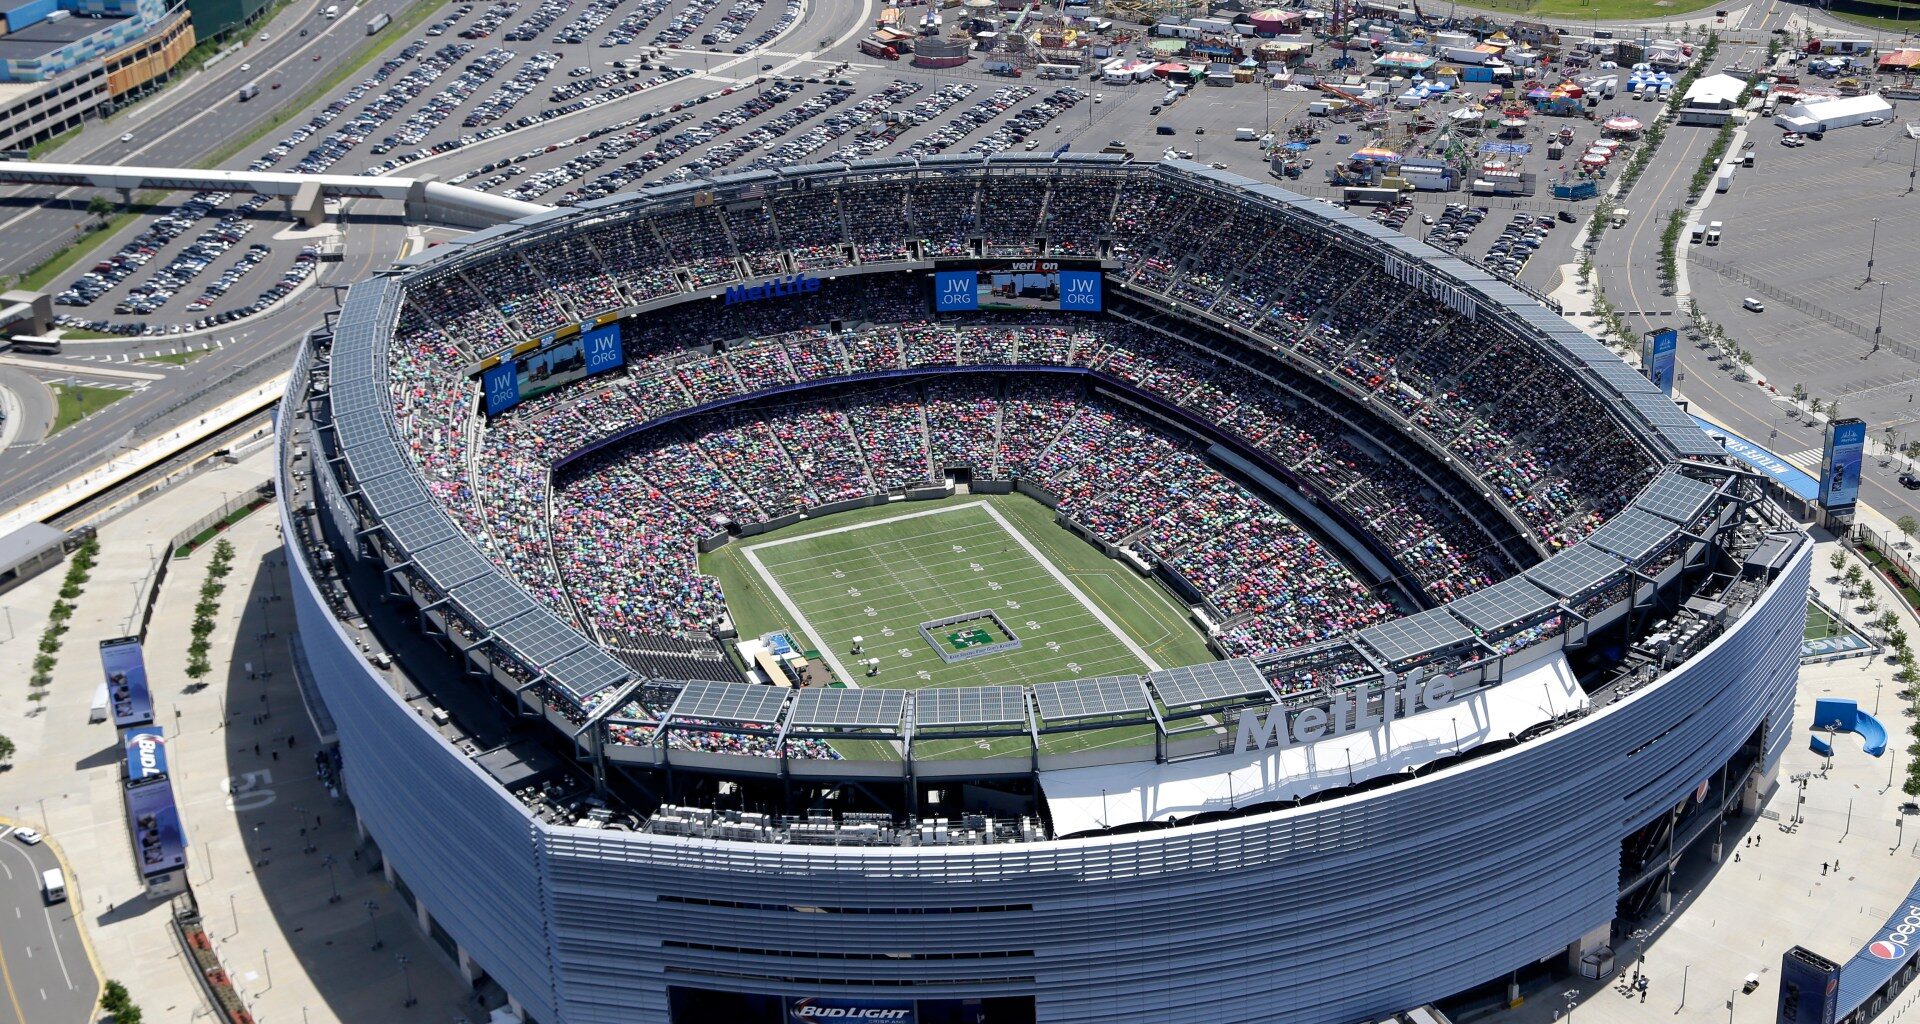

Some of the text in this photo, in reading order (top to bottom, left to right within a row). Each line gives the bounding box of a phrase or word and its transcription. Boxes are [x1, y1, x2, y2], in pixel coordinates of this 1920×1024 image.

[1012, 261, 1058, 273] verizon
[725, 272, 820, 305] MetLife
[944, 279, 969, 293] JW
[1068, 279, 1094, 293] JW
[1385, 254, 1476, 322] METLIFE STADIUM
[942, 294, 970, 305] .ORG
[1066, 294, 1094, 304] .ORG
[591, 334, 614, 354] JW
[590, 350, 616, 367] .ORG
[492, 372, 511, 394] JW
[491, 389, 513, 407] .ORG
[1744, 448, 1789, 474] METLIFE
[1234, 666, 1454, 755] MetLife
[138, 740, 156, 767] BUD
[800, 1006, 909, 1019] BUD LIGHT
